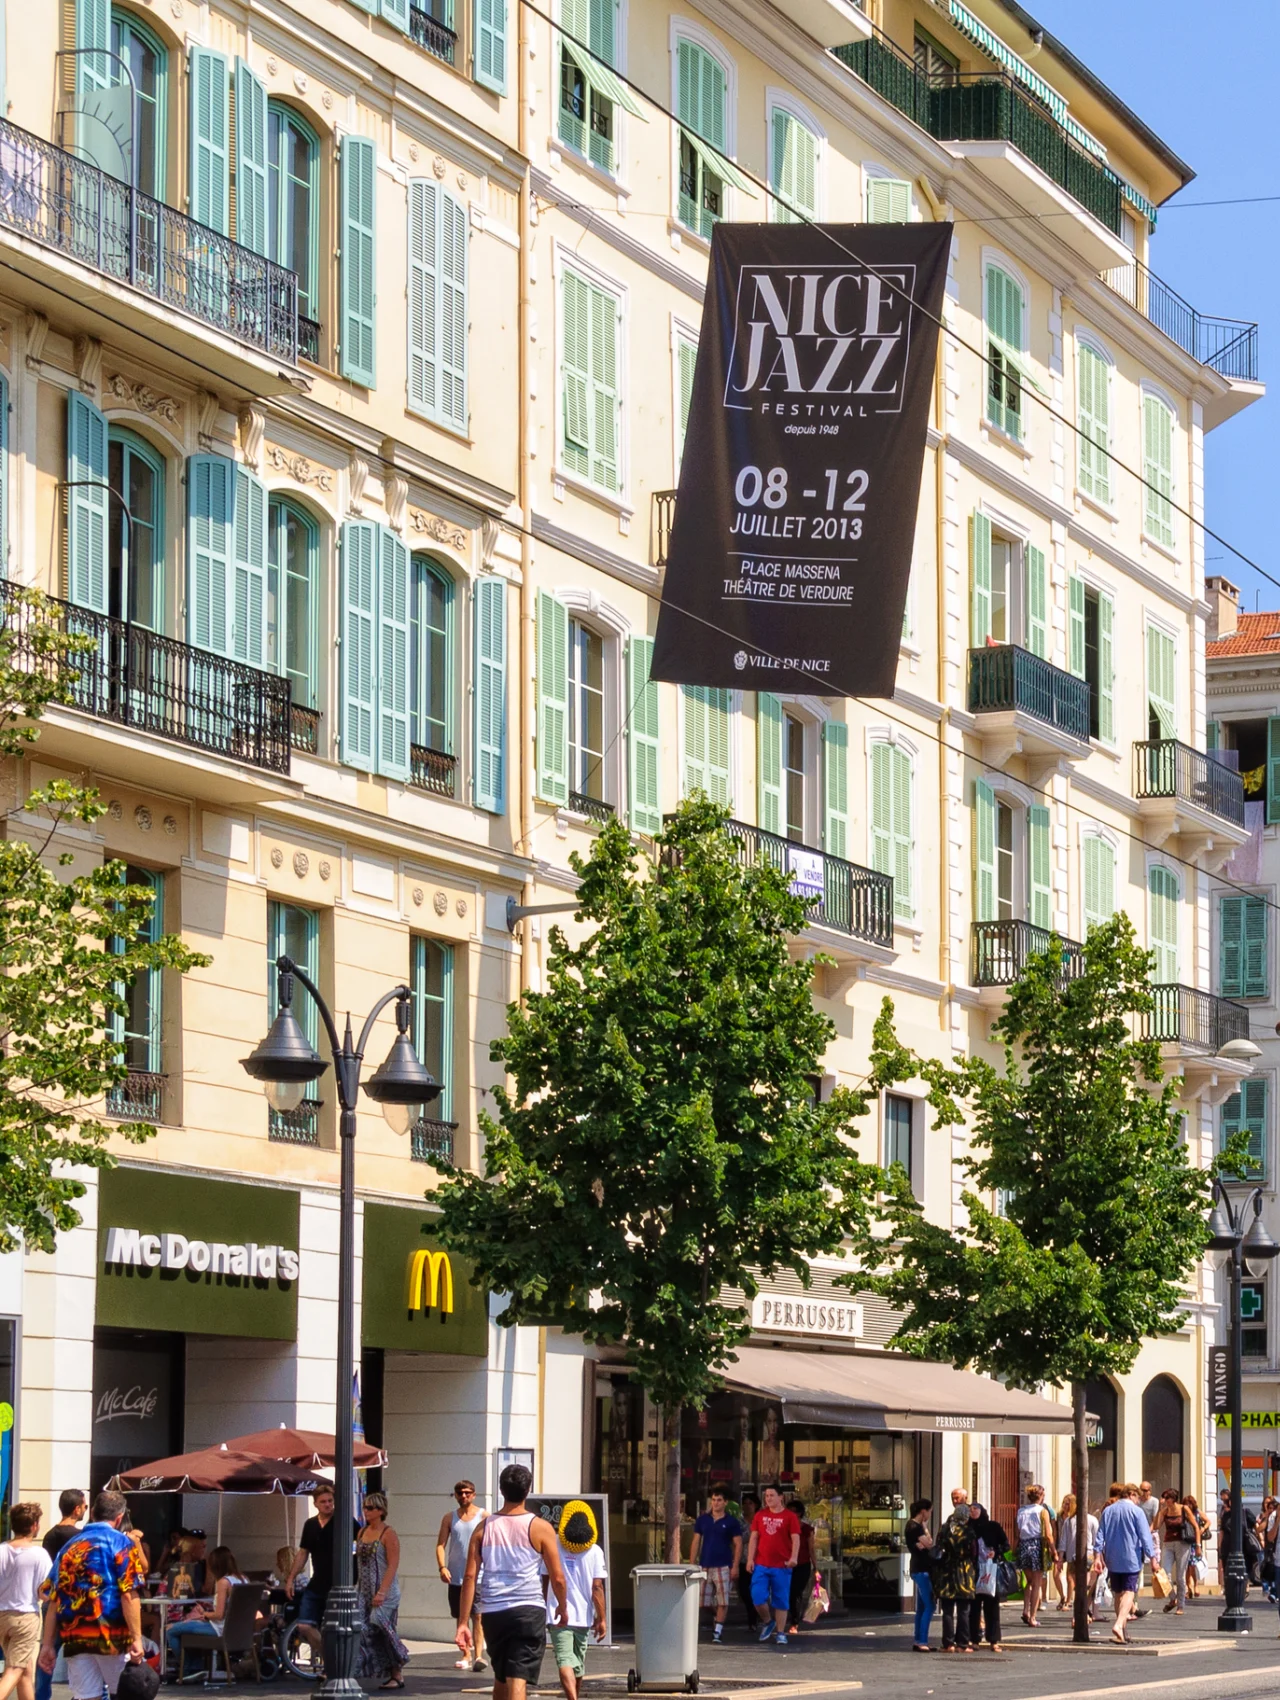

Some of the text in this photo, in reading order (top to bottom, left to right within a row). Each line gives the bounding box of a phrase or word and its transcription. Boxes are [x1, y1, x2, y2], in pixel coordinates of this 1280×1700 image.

[751, 272, 906, 336] NICE
[732, 322, 899, 394] JAZZ
[761, 403, 867, 417] FESTIVAL
[784, 424, 839, 435] depuis 1948
[735, 465, 788, 509] 08
[729, 512, 863, 540] JUILLET 2013
[741, 560, 840, 580] PLACE MASSENA
[723, 577, 854, 600] THÉÂTRE DE VERDURE
[749, 655, 831, 672] VILLE DE NICE
[803, 869, 823, 883] VENDRE
[105, 1227, 300, 1281] McDonald's
[762, 1300, 857, 1332] PERRUSSET
[1215, 1352, 1227, 1407] MANGO
[96, 1385, 157, 1421] McCafé
[935, 1415, 975, 1429] PERRUSSET
